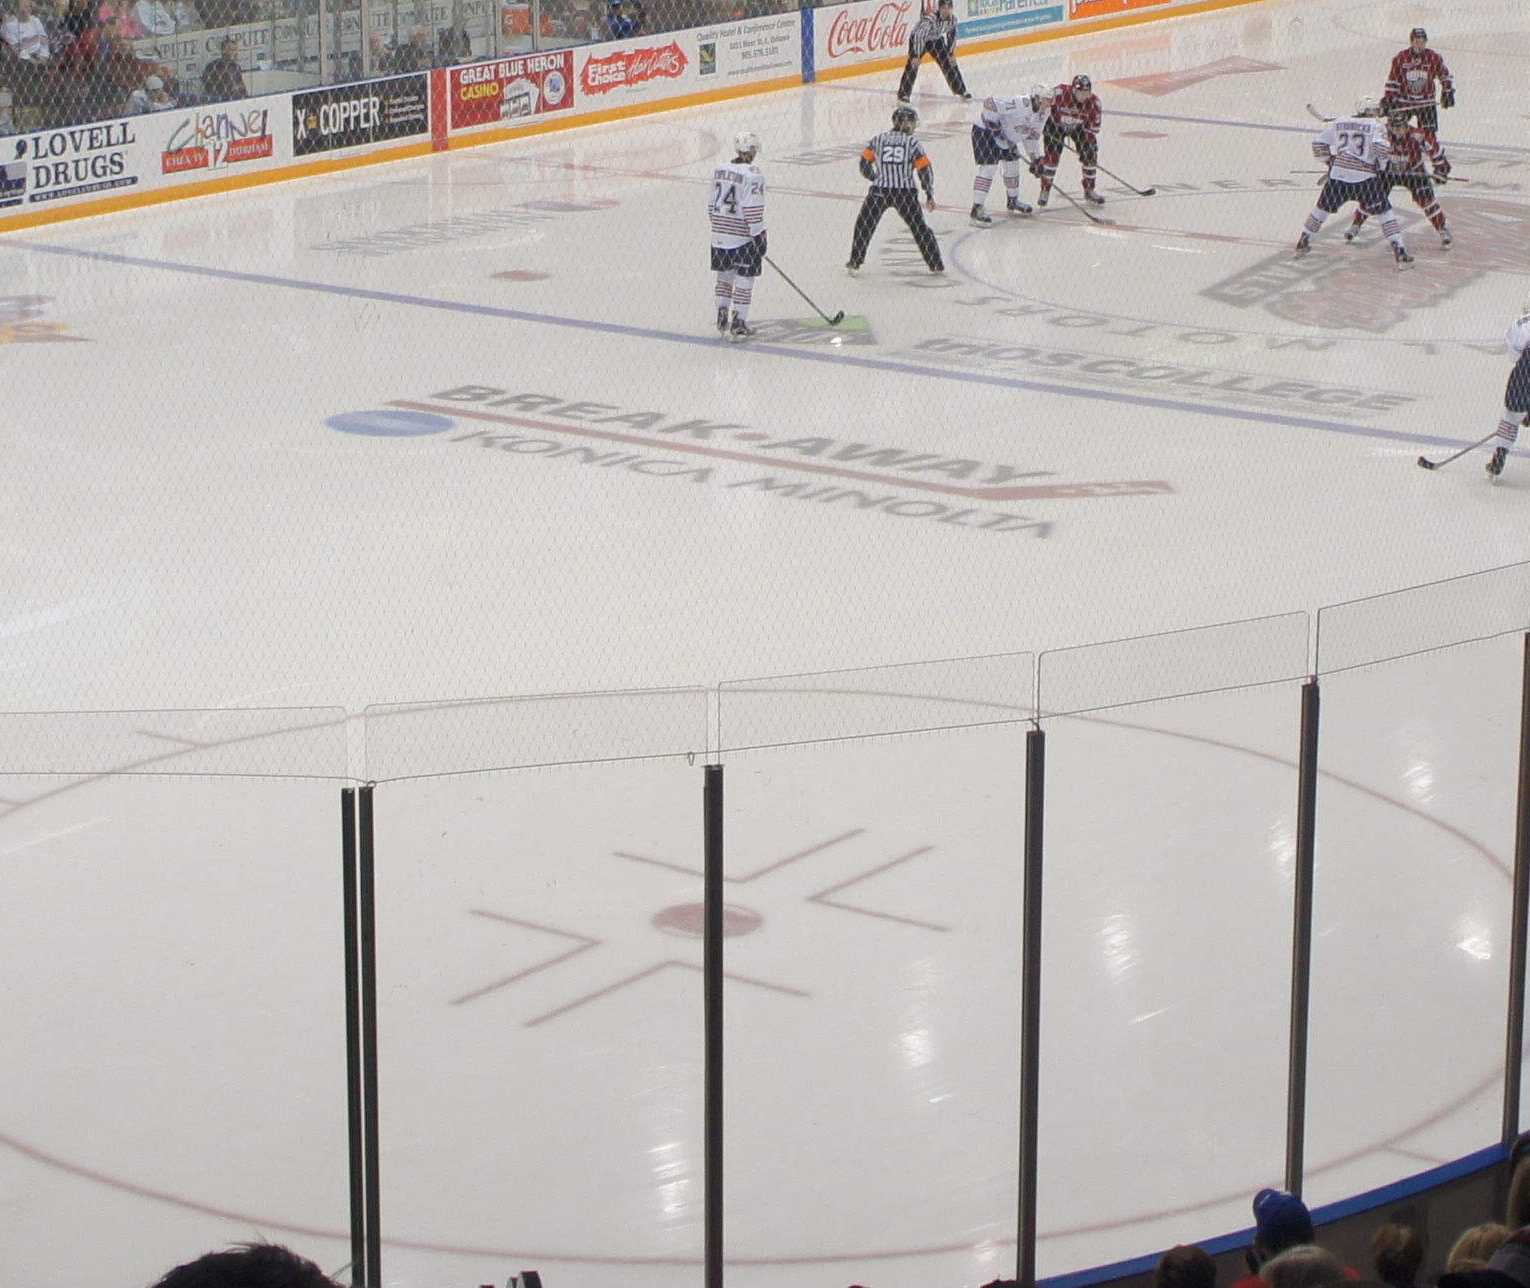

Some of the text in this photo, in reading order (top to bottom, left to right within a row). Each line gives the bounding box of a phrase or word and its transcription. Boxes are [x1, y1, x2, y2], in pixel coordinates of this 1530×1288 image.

[827, 0, 913, 59] Coca-Cola
[459, 53, 565, 86] GREAT BLUE HERON
[587, 59, 626, 76] First
[587, 70, 627, 87] Choice
[459, 81, 500, 101] CASINO
[319, 95, 381, 137] COPPER
[31, 121, 136, 162] LOVELL
[207, 139, 229, 171] 12
[1337, 133, 1366, 157] 23
[32, 151, 126, 191] DRUGS
[449, 429, 1056, 539] KONICA MINOLTA
